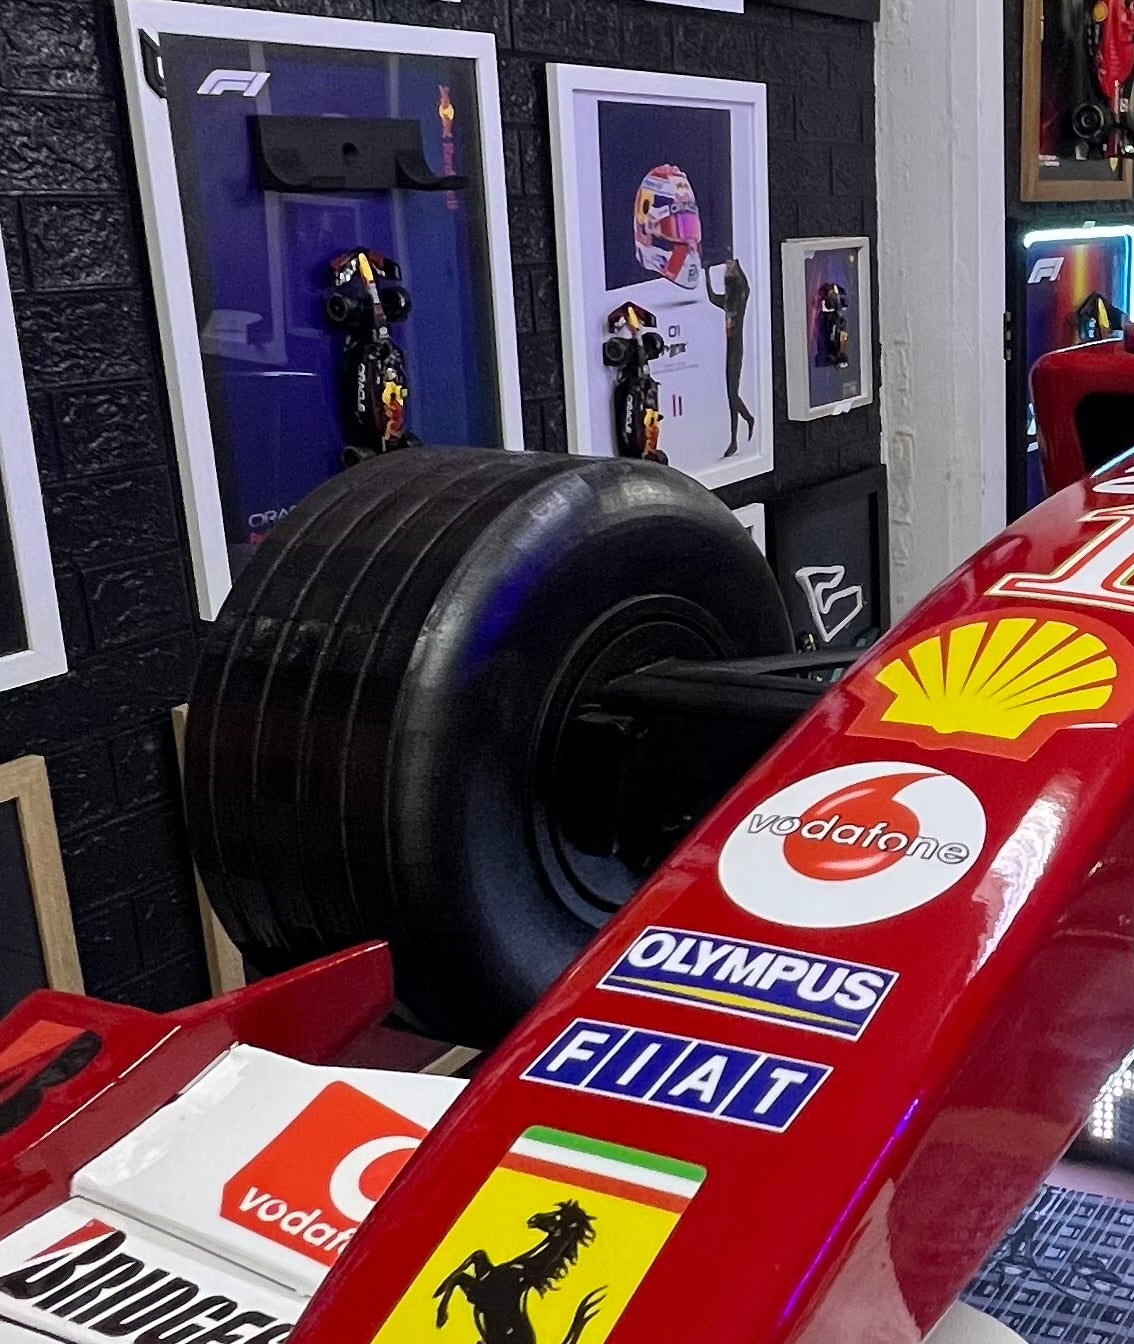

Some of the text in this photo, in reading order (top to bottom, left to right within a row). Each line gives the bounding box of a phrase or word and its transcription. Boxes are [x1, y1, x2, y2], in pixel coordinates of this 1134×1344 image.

[248, 505, 297, 527] ORA
[747, 811, 969, 865] vodafone
[626, 932, 885, 1011] OLYMPUS
[546, 1029, 808, 1115] FIAT
[238, 1186, 358, 1256] vodaf
